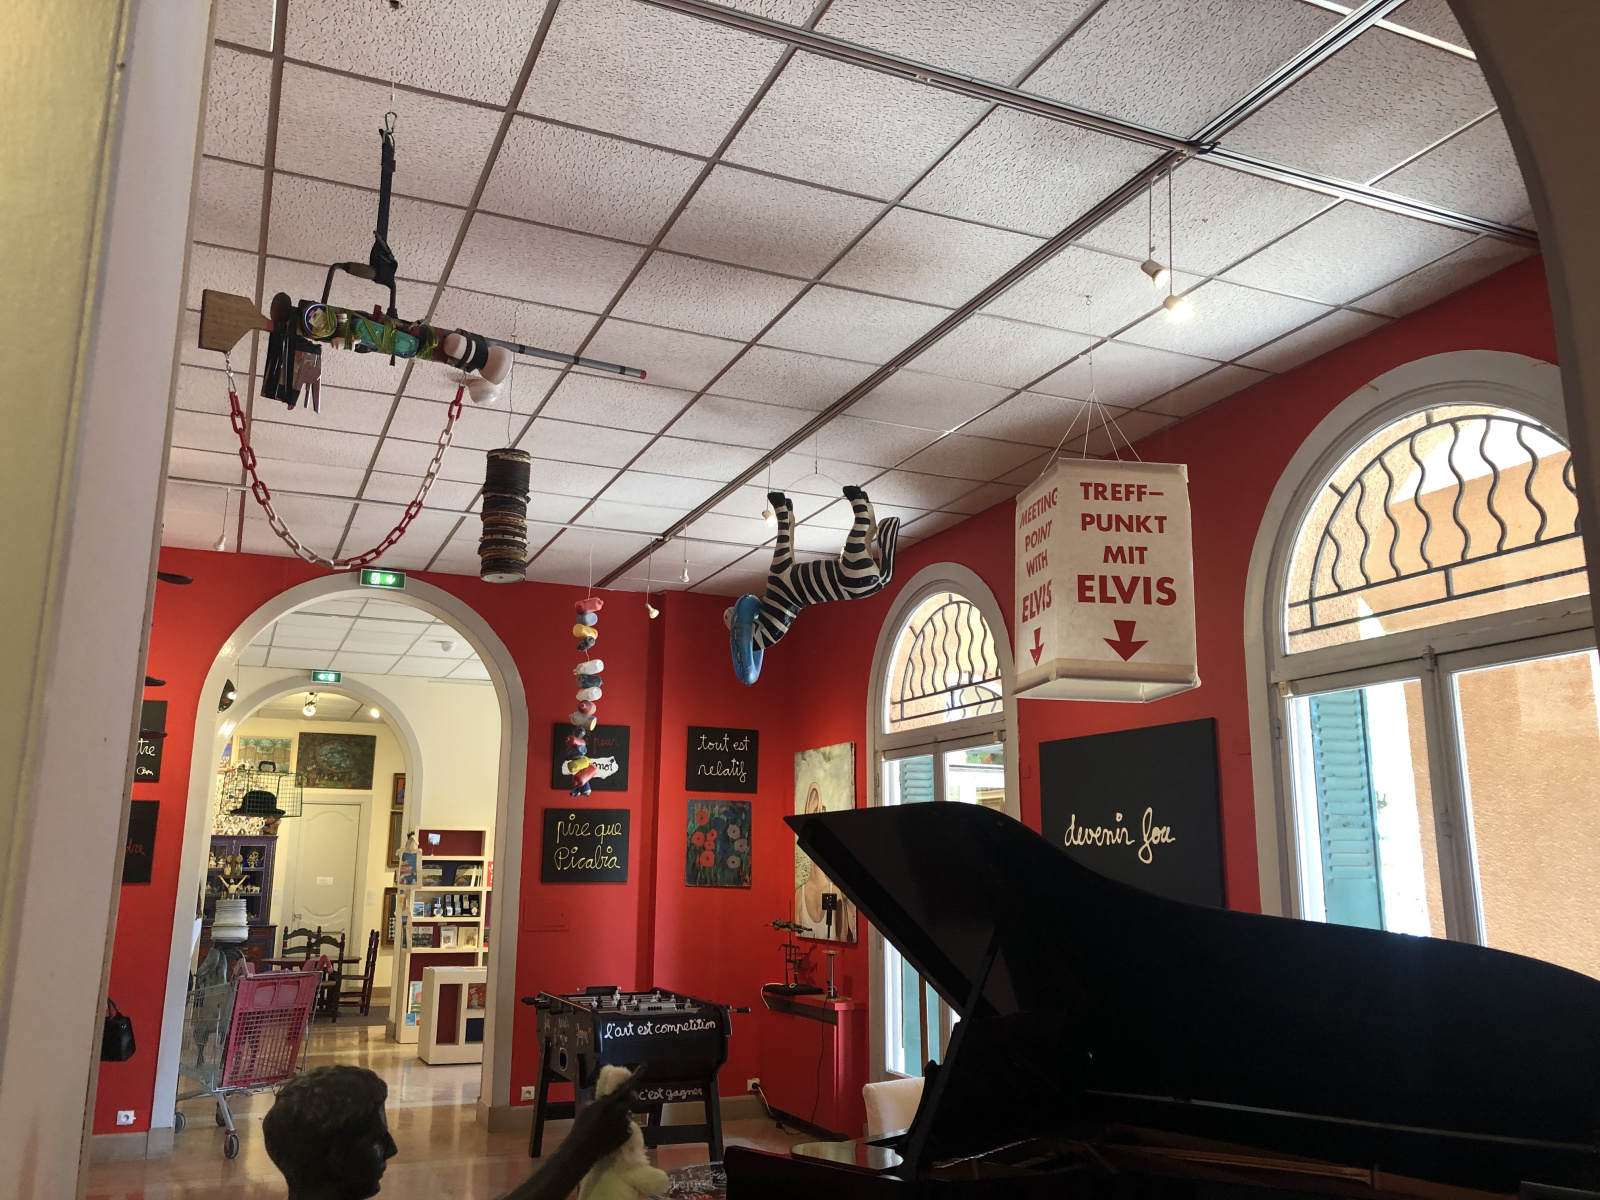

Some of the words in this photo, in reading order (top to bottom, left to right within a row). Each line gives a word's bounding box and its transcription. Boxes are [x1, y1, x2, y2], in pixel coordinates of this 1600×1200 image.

[1019, 487, 1058, 529] MEETING
[1025, 520, 1053, 552] POINT
[1081, 513, 1167, 534] PUNKT
[1026, 549, 1048, 578] WITH
[1103, 546, 1148, 565] MIT
[1022, 579, 1052, 623] ELVIS
[1077, 574, 1177, 606] ELVIS
[697, 733, 730, 751] tout
[733, 736, 750, 751] est
[698, 758, 747, 783] relatif
[556, 814, 591, 843] pire
[595, 822, 622, 844] que
[1064, 812, 1135, 847] devenir
[1138, 807, 1176, 864] fou
[554, 845, 621, 870] Picabia
[604, 1022, 635, 1039] l'art
[637, 1021, 653, 1035] est
[638, 1087, 664, 1101] c'est
